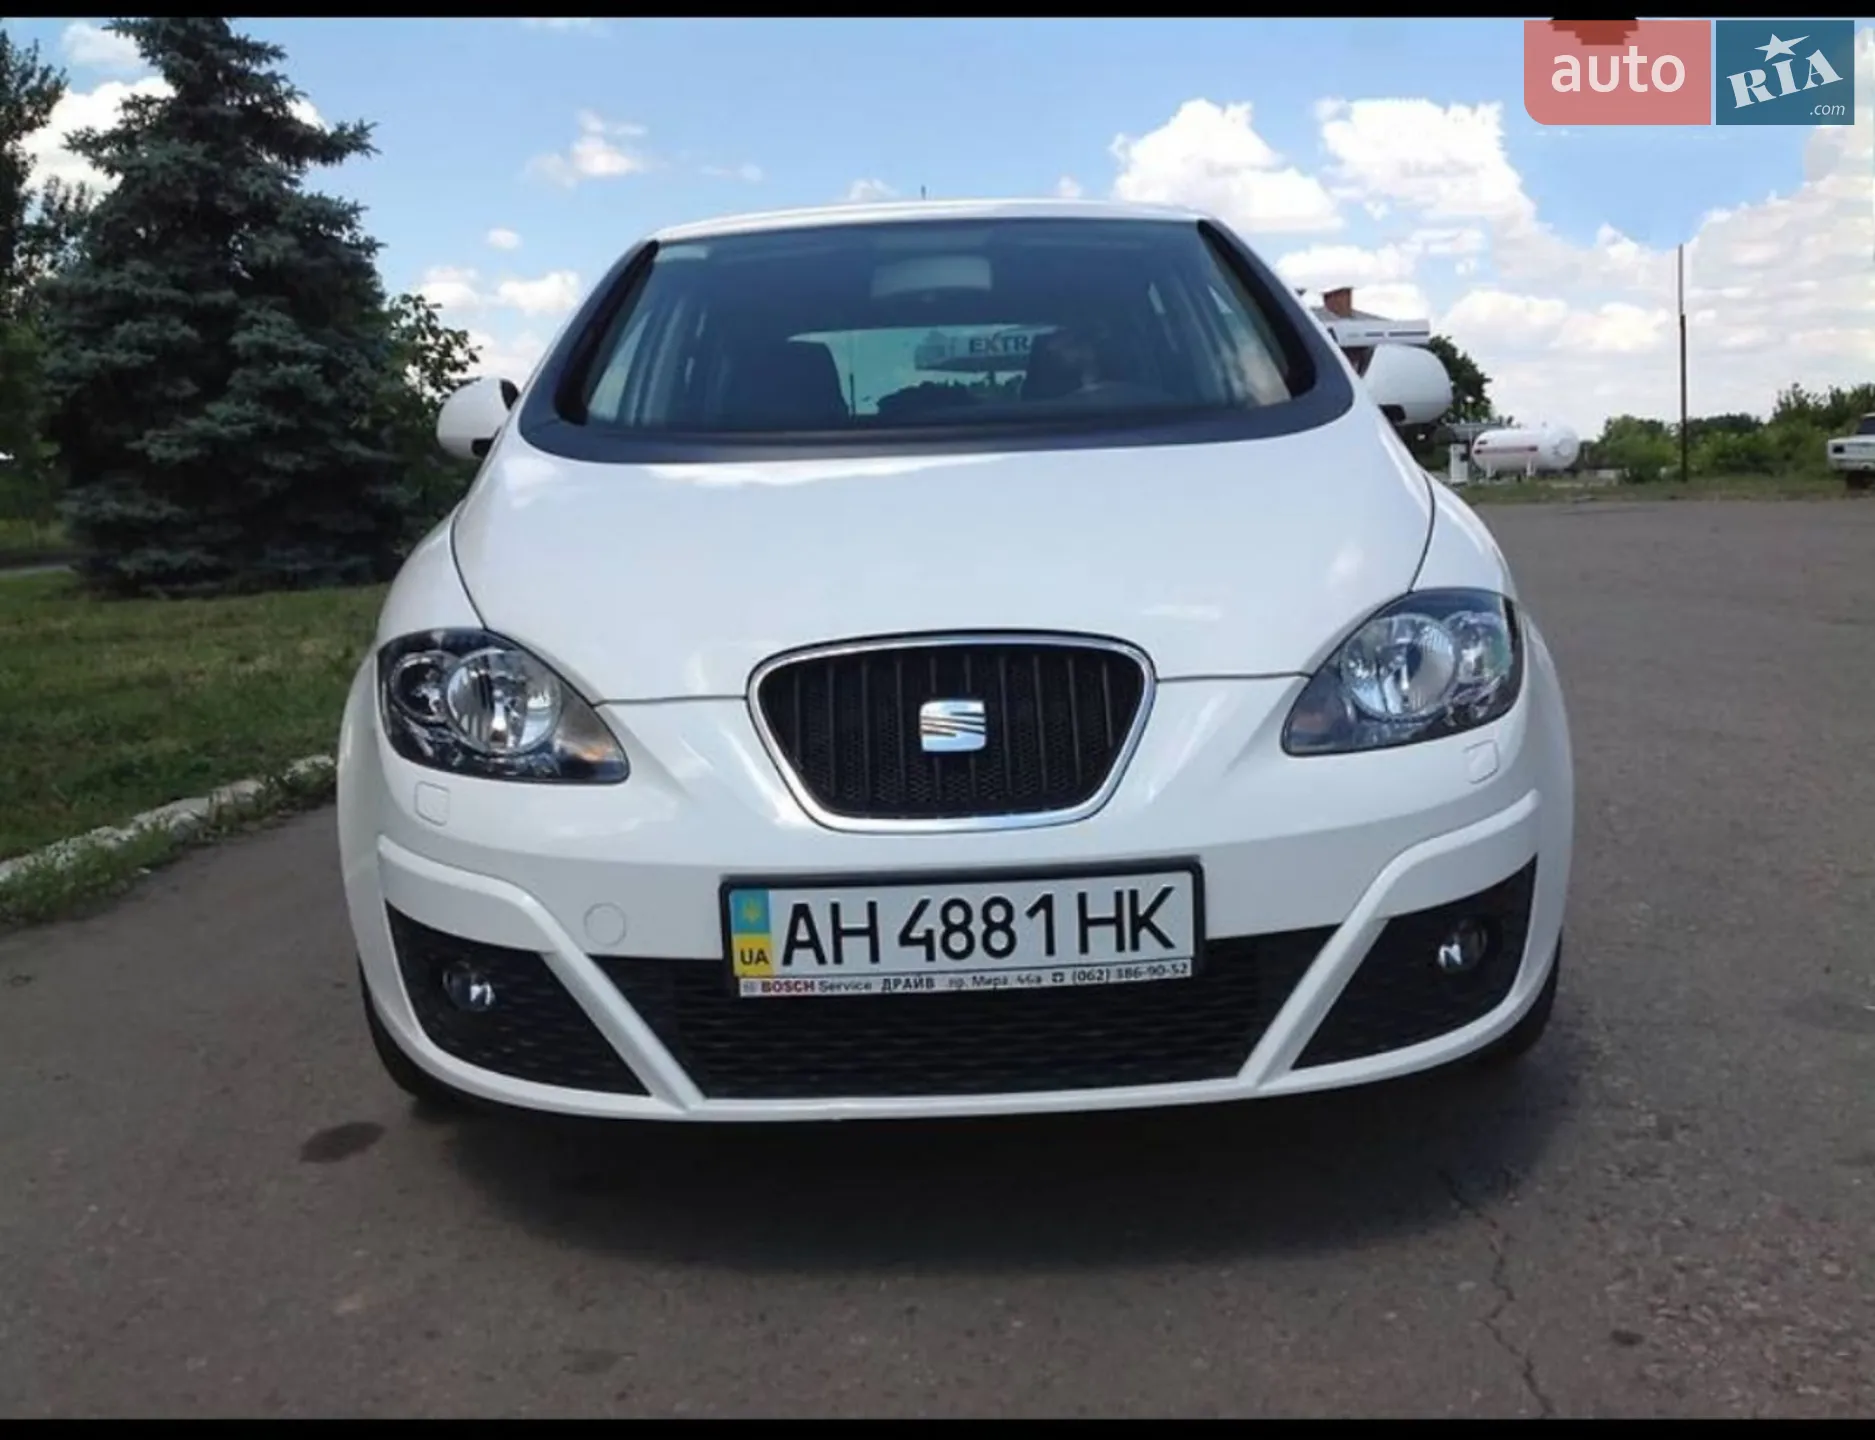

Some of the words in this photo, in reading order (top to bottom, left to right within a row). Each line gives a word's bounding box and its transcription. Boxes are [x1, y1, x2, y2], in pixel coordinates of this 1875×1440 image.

[782, 901, 880, 966] AH
[898, 893, 1055, 962] 4881
[1077, 886, 1175, 955] HK
[740, 948, 770, 966] UA
[761, 980, 815, 993] BOSCH
[818, 978, 872, 992] Service
[881, 975, 936, 991] ДРАЙВ
[1072, 967, 1110, 984] (062)
